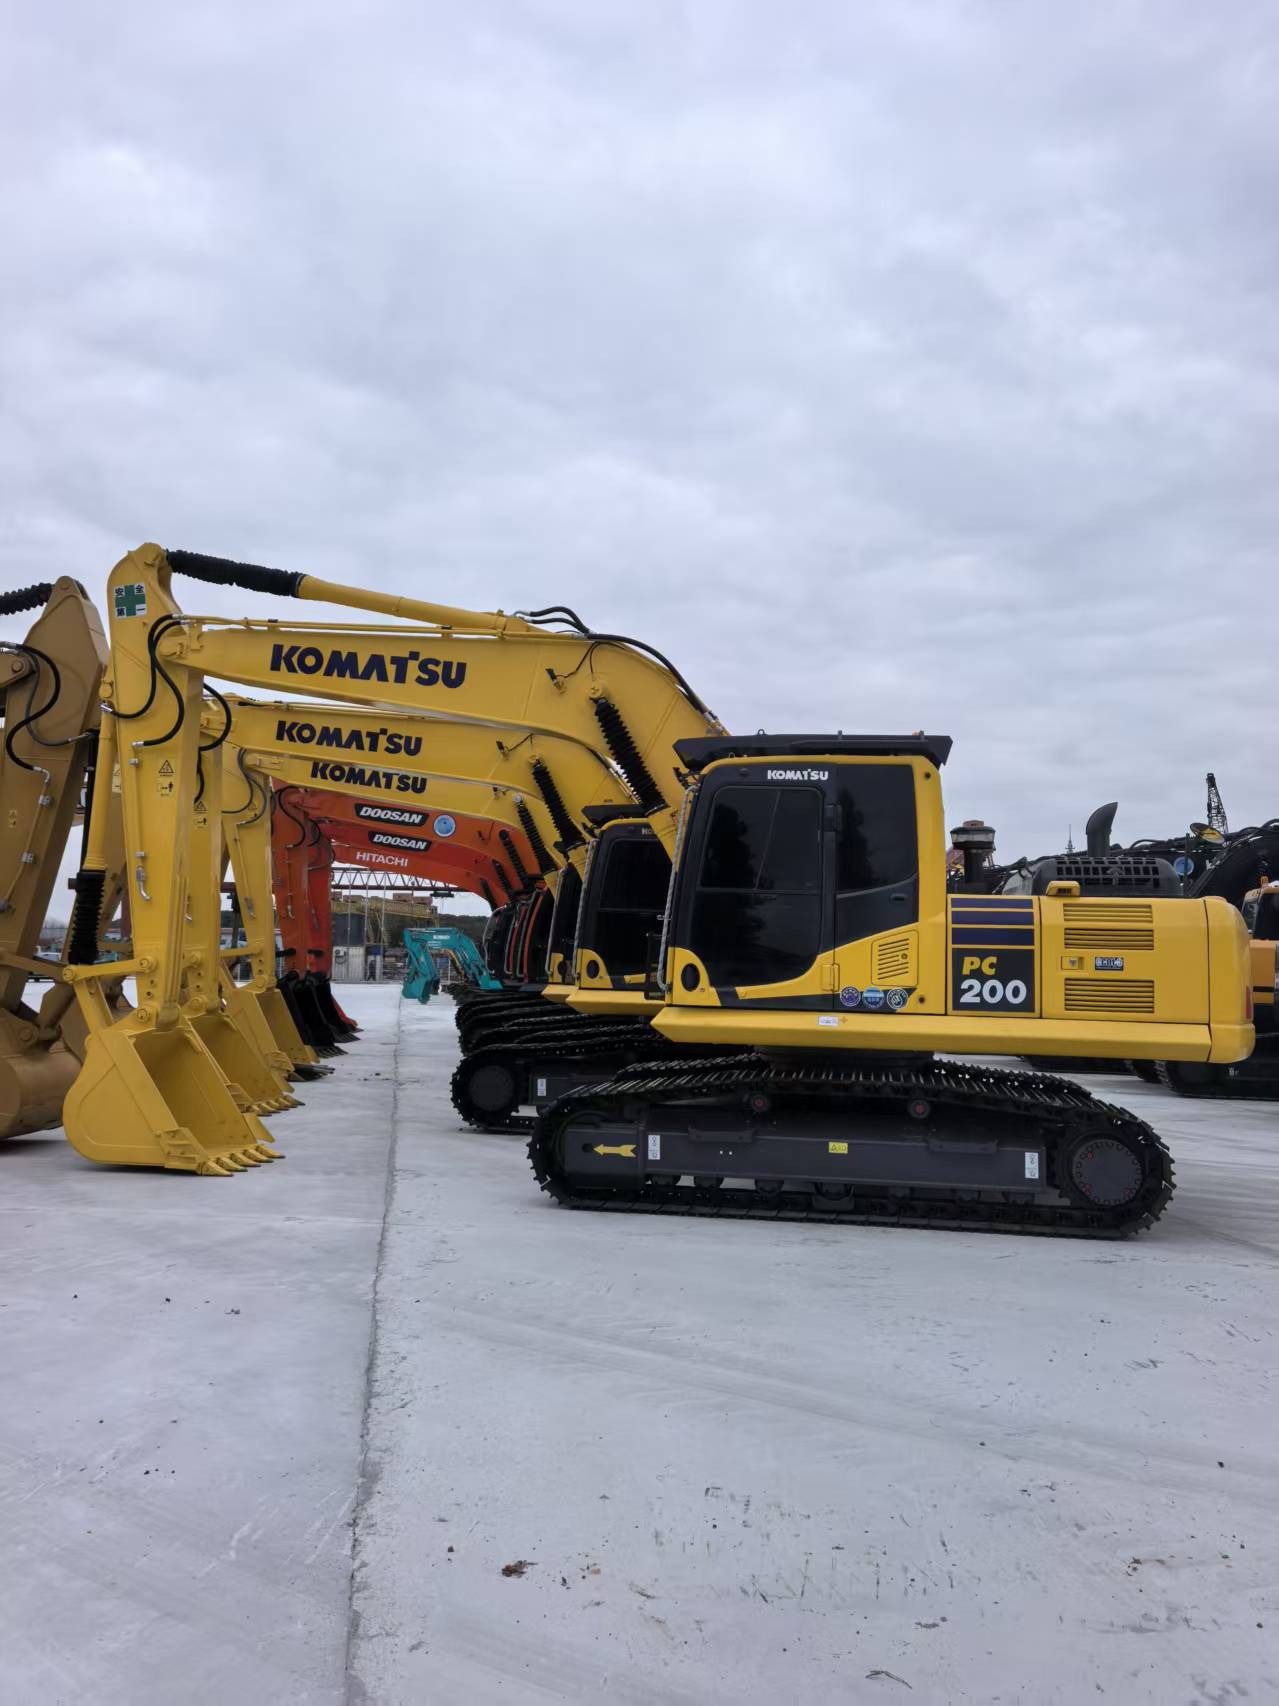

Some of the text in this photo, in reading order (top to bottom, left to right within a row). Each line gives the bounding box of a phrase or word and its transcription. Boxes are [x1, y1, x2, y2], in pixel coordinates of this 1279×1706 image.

[271, 644, 466, 689] KOMATSU
[276, 719, 422, 757] KOMATSU
[311, 761, 428, 794] KOMATSU
[767, 769, 829, 781] KOMATSU
[360, 806, 423, 824] DOOSAN
[373, 834, 427, 850] DOOSAN
[356, 851, 409, 867] HITACHI
[962, 956, 997, 976] PC
[960, 978, 1027, 1004] 200
